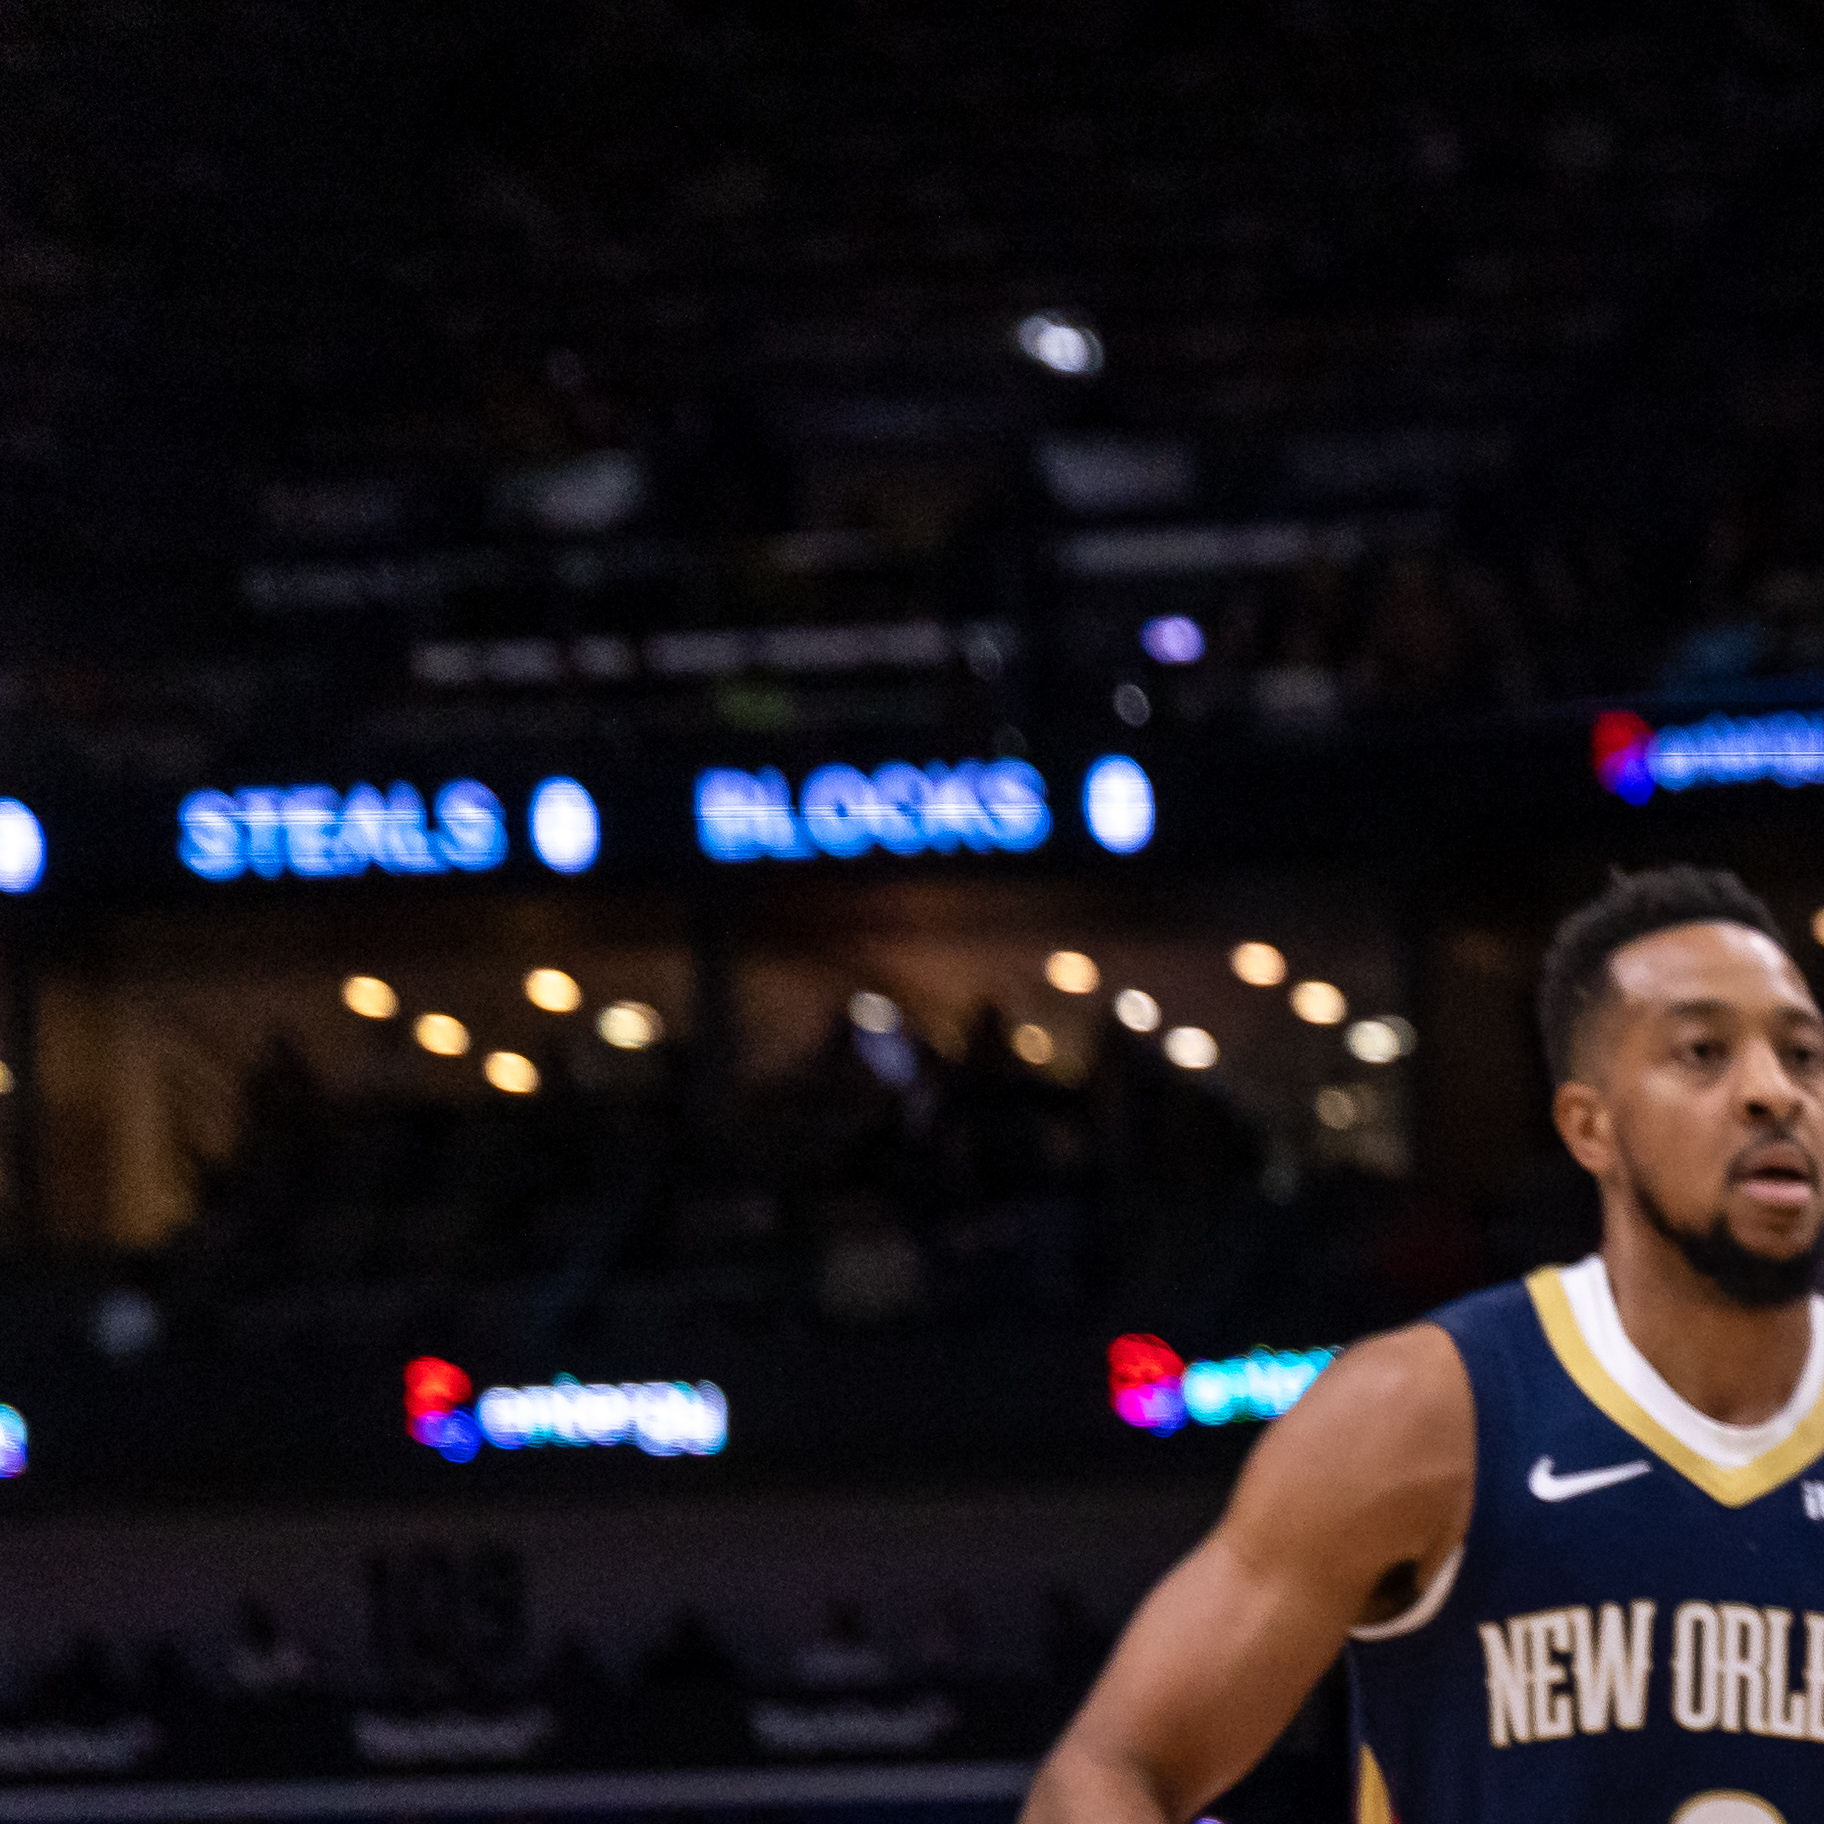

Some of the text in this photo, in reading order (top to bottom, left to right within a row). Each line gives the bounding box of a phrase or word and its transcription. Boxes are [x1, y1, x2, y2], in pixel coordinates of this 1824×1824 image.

[179, 778, 508, 880] STEALS
[695, 757, 1051, 862] BLOCKS
[1477, 1599, 1657, 1749] NEW
